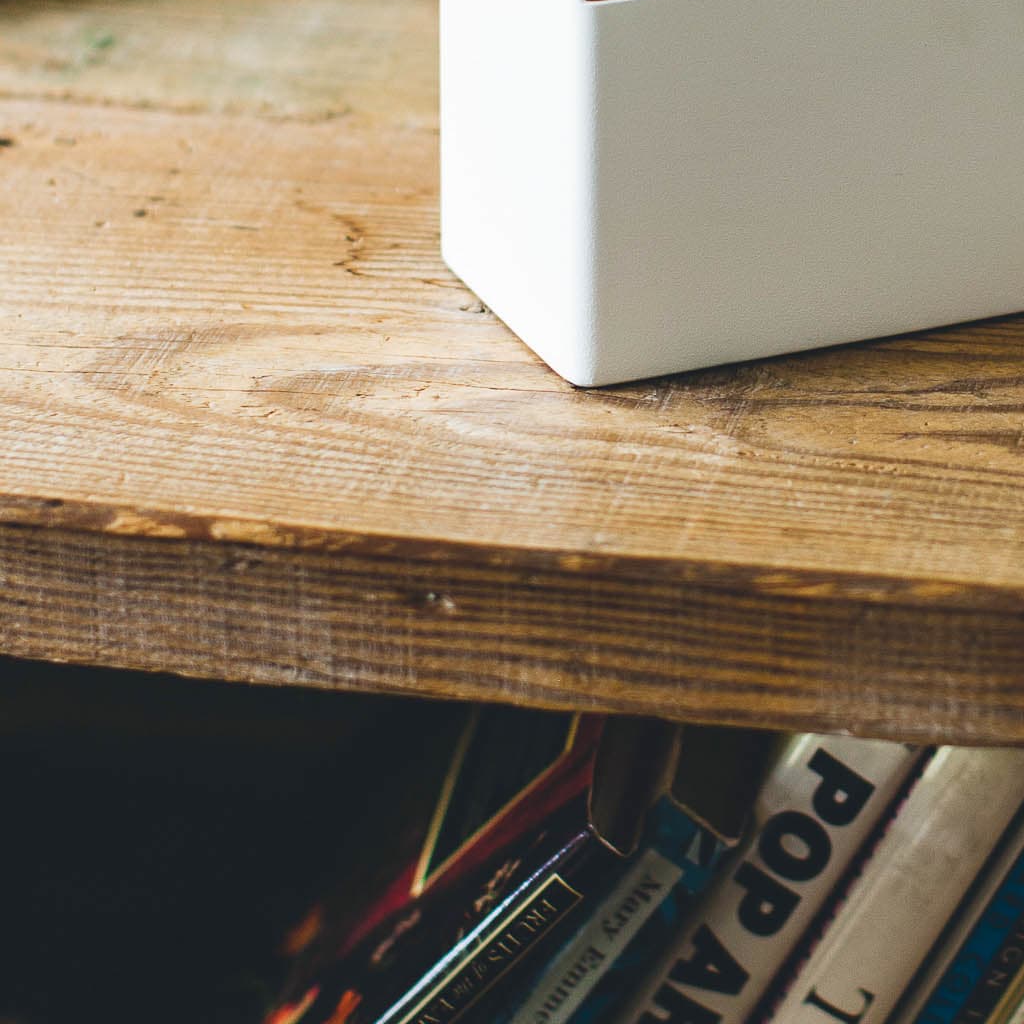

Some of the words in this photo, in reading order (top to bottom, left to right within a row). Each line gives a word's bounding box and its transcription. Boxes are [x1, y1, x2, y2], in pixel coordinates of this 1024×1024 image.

[732, 747, 877, 937] POP
[488, 898, 558, 963] FRUITS
[600, 881, 663, 942] Mary
